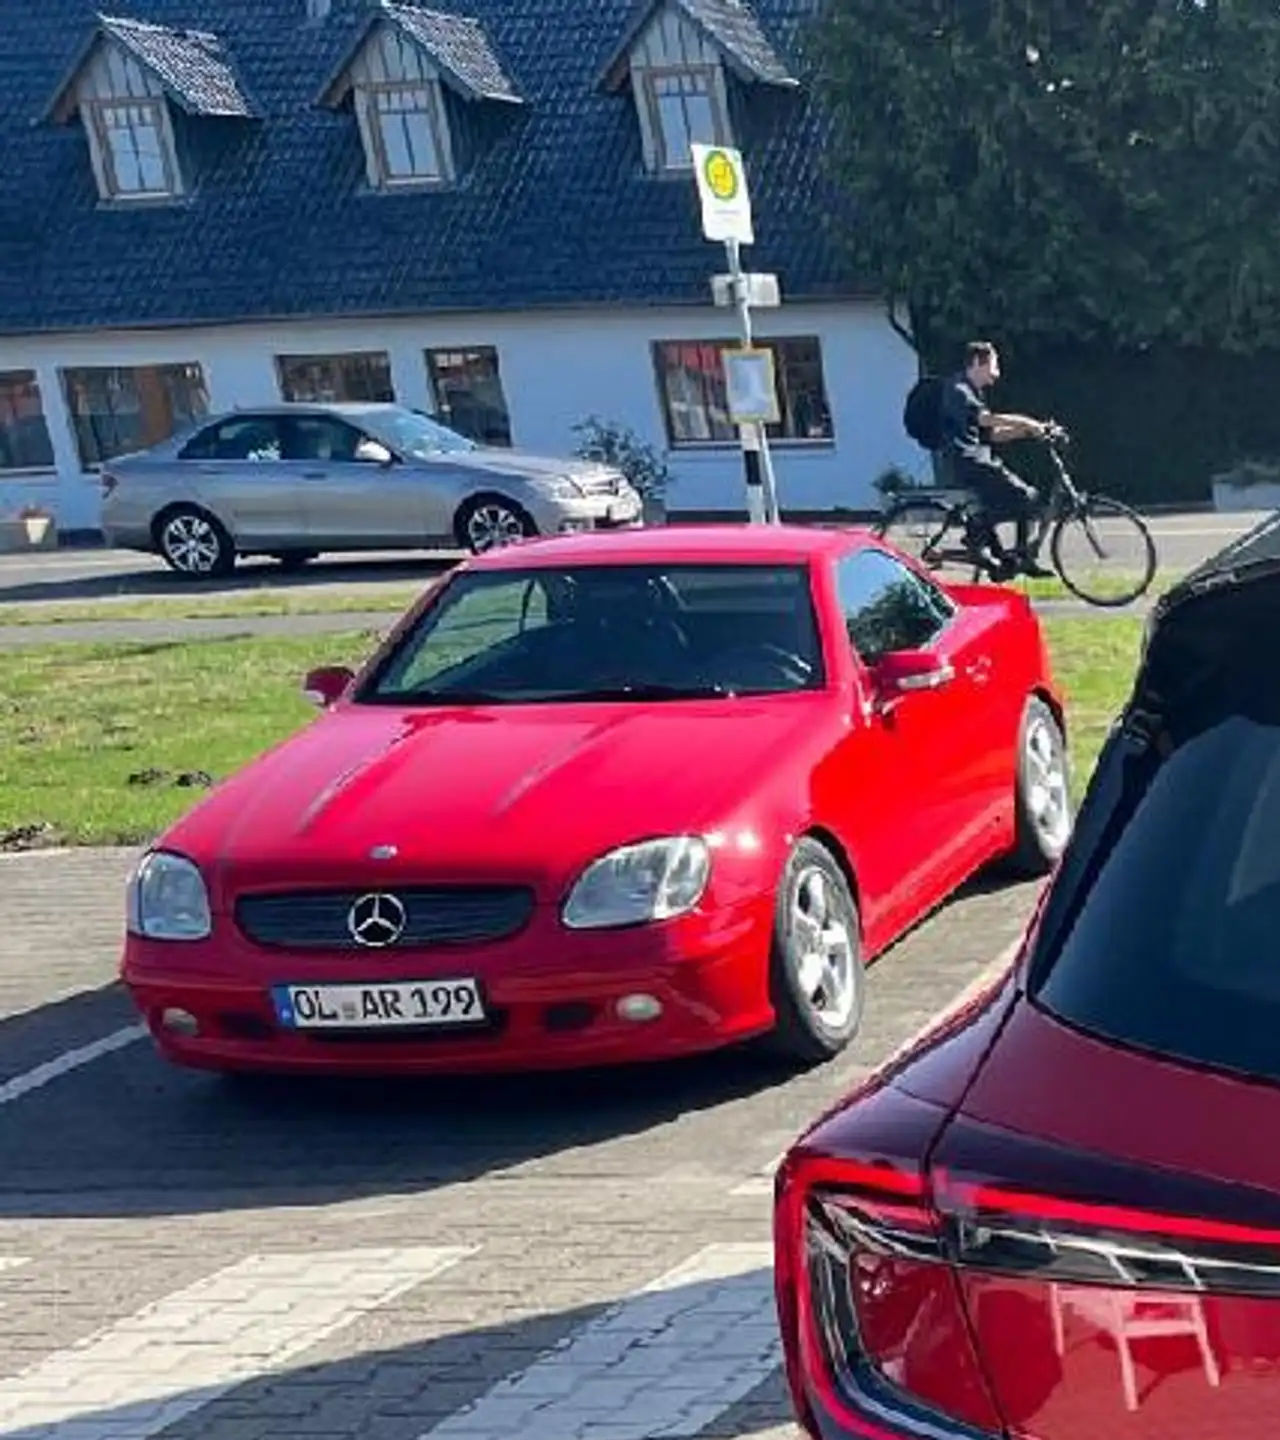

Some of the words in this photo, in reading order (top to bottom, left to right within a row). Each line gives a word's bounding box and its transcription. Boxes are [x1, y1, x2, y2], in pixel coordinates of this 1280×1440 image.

[294, 989, 338, 1021] OL
[361, 989, 403, 1018] AR
[410, 987, 476, 1017] 199
